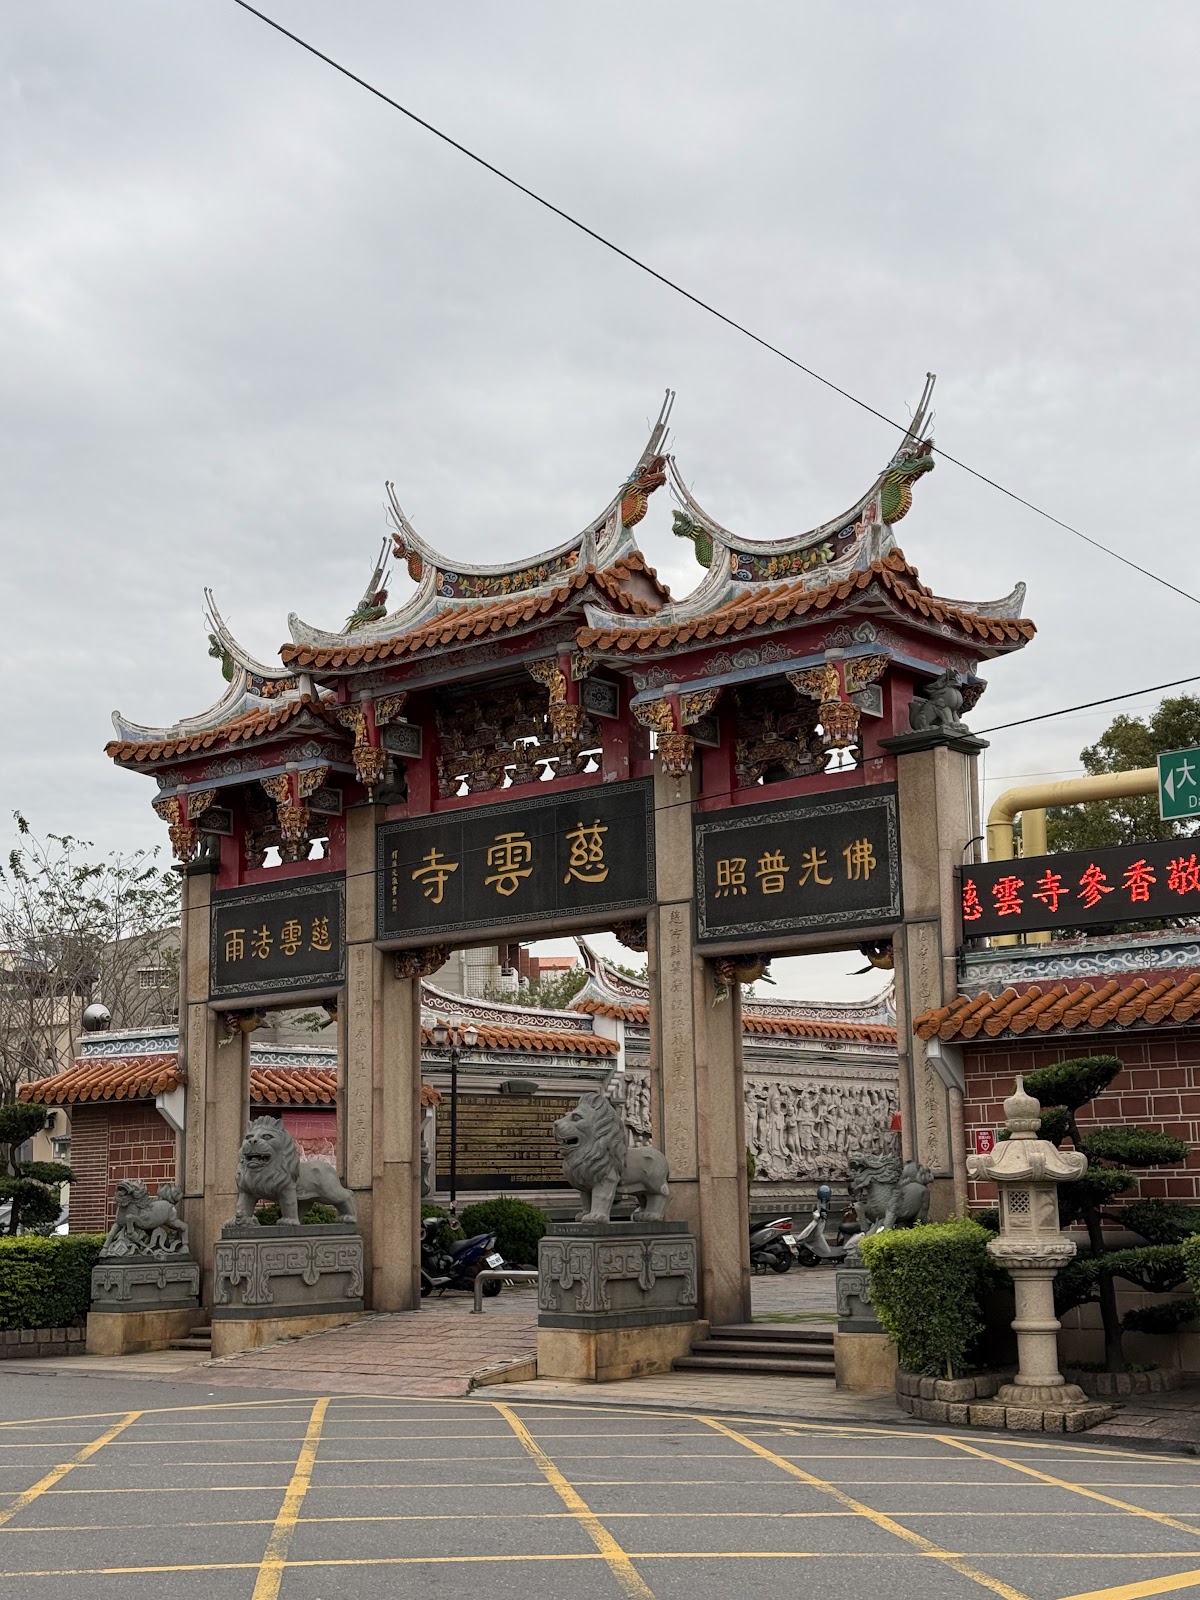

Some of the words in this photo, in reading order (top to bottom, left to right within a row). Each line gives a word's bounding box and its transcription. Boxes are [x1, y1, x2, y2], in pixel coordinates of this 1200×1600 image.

[1176, 758, 1197, 789] 大
[1189, 795, 1200, 808] D
[411, 819, 609, 904] 慈雲寺
[714, 838, 877, 898] 佛光普照
[223, 916, 332, 962] 慈雲法雨
